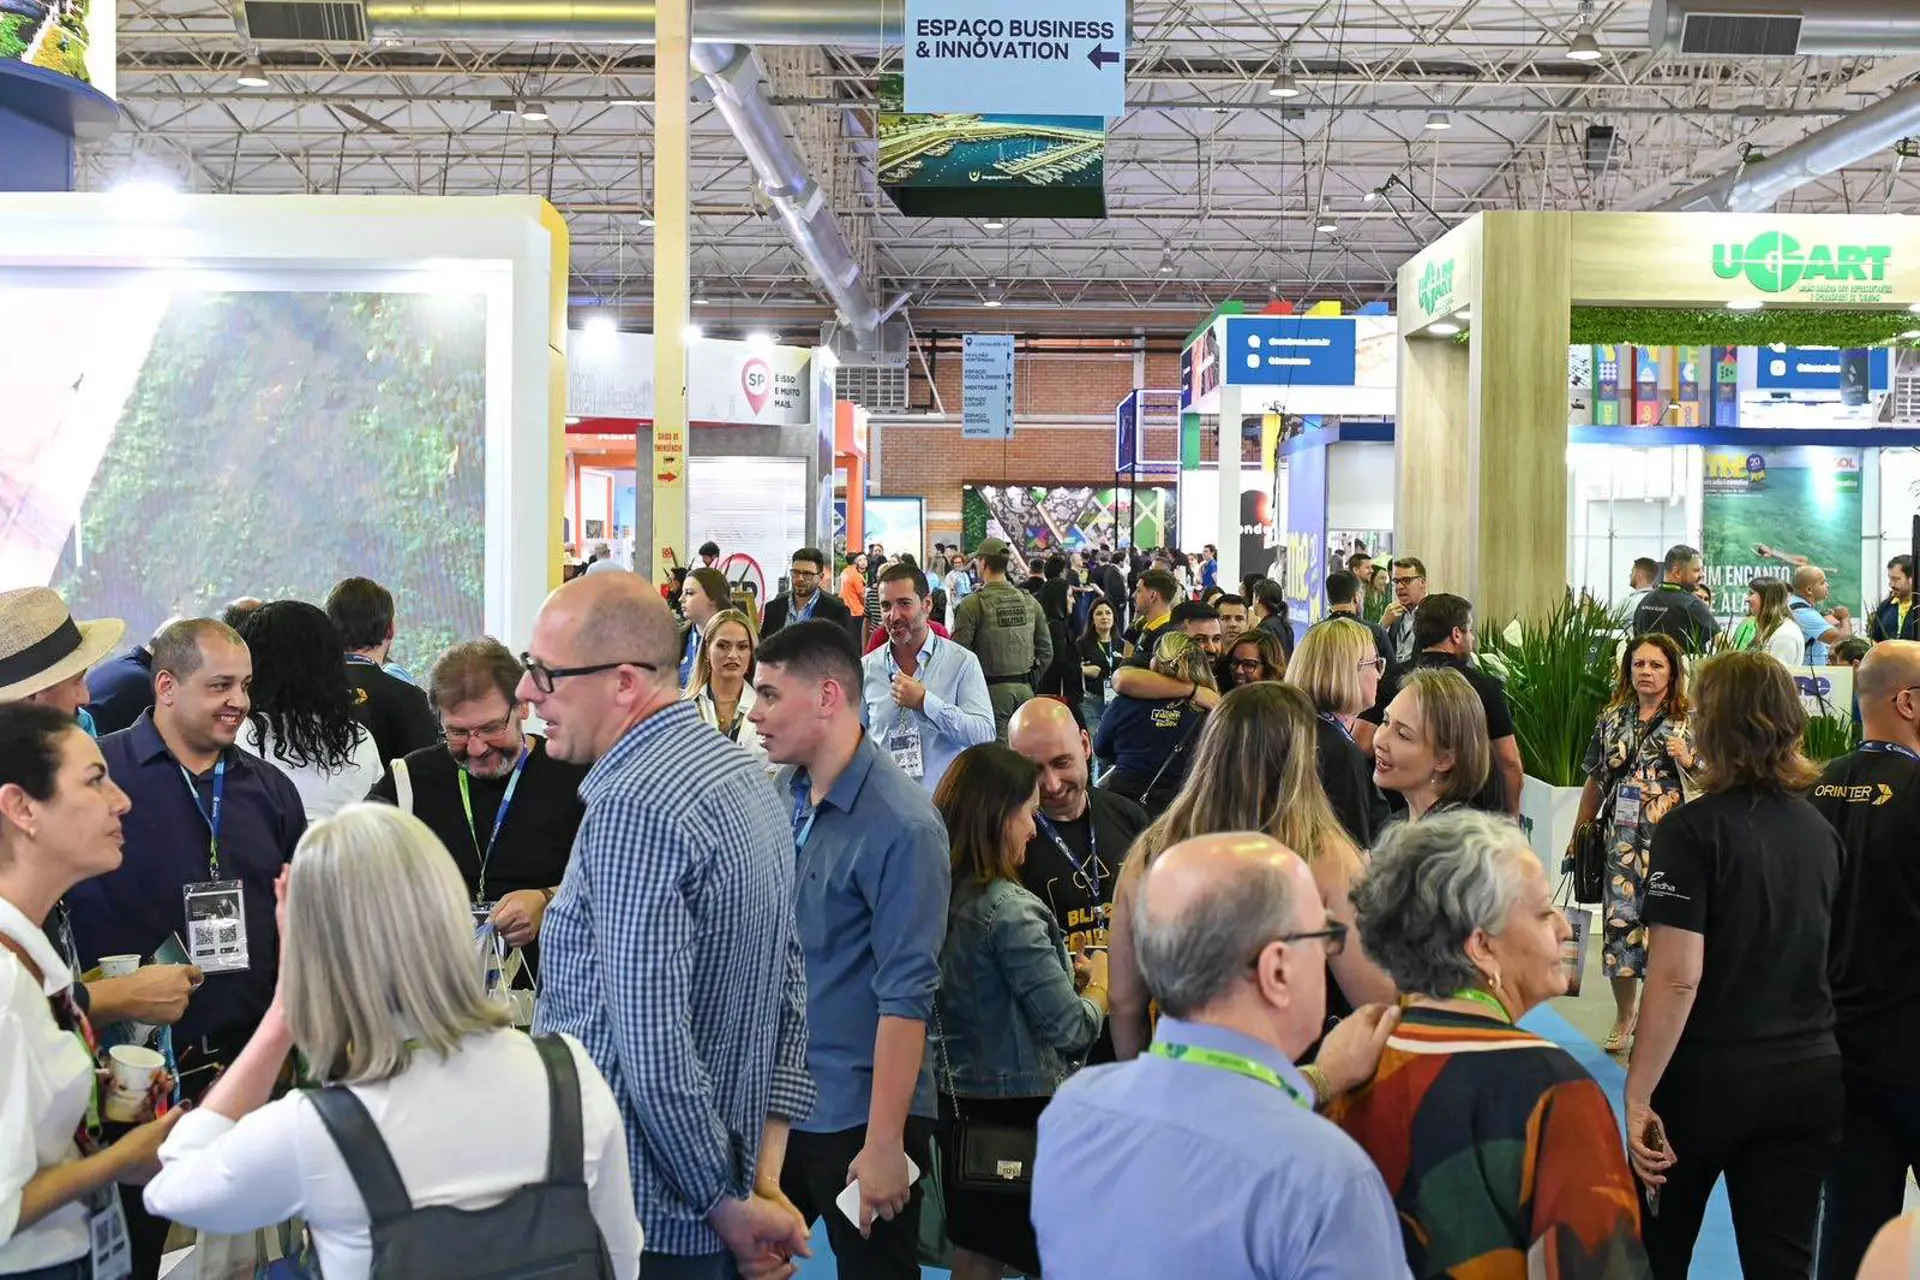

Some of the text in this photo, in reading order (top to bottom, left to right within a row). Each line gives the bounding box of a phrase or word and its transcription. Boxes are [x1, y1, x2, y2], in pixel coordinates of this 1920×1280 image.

[917, 19, 1115, 41] ESPAÇO BUSINESS
[916, 41, 1069, 60] & INNOVATION
[749, 373, 765, 386] SP
[781, 387, 800, 396] MUITO
[1000, 615, 1026, 626] MILITAR
[1815, 784, 1873, 798] ORINTER
